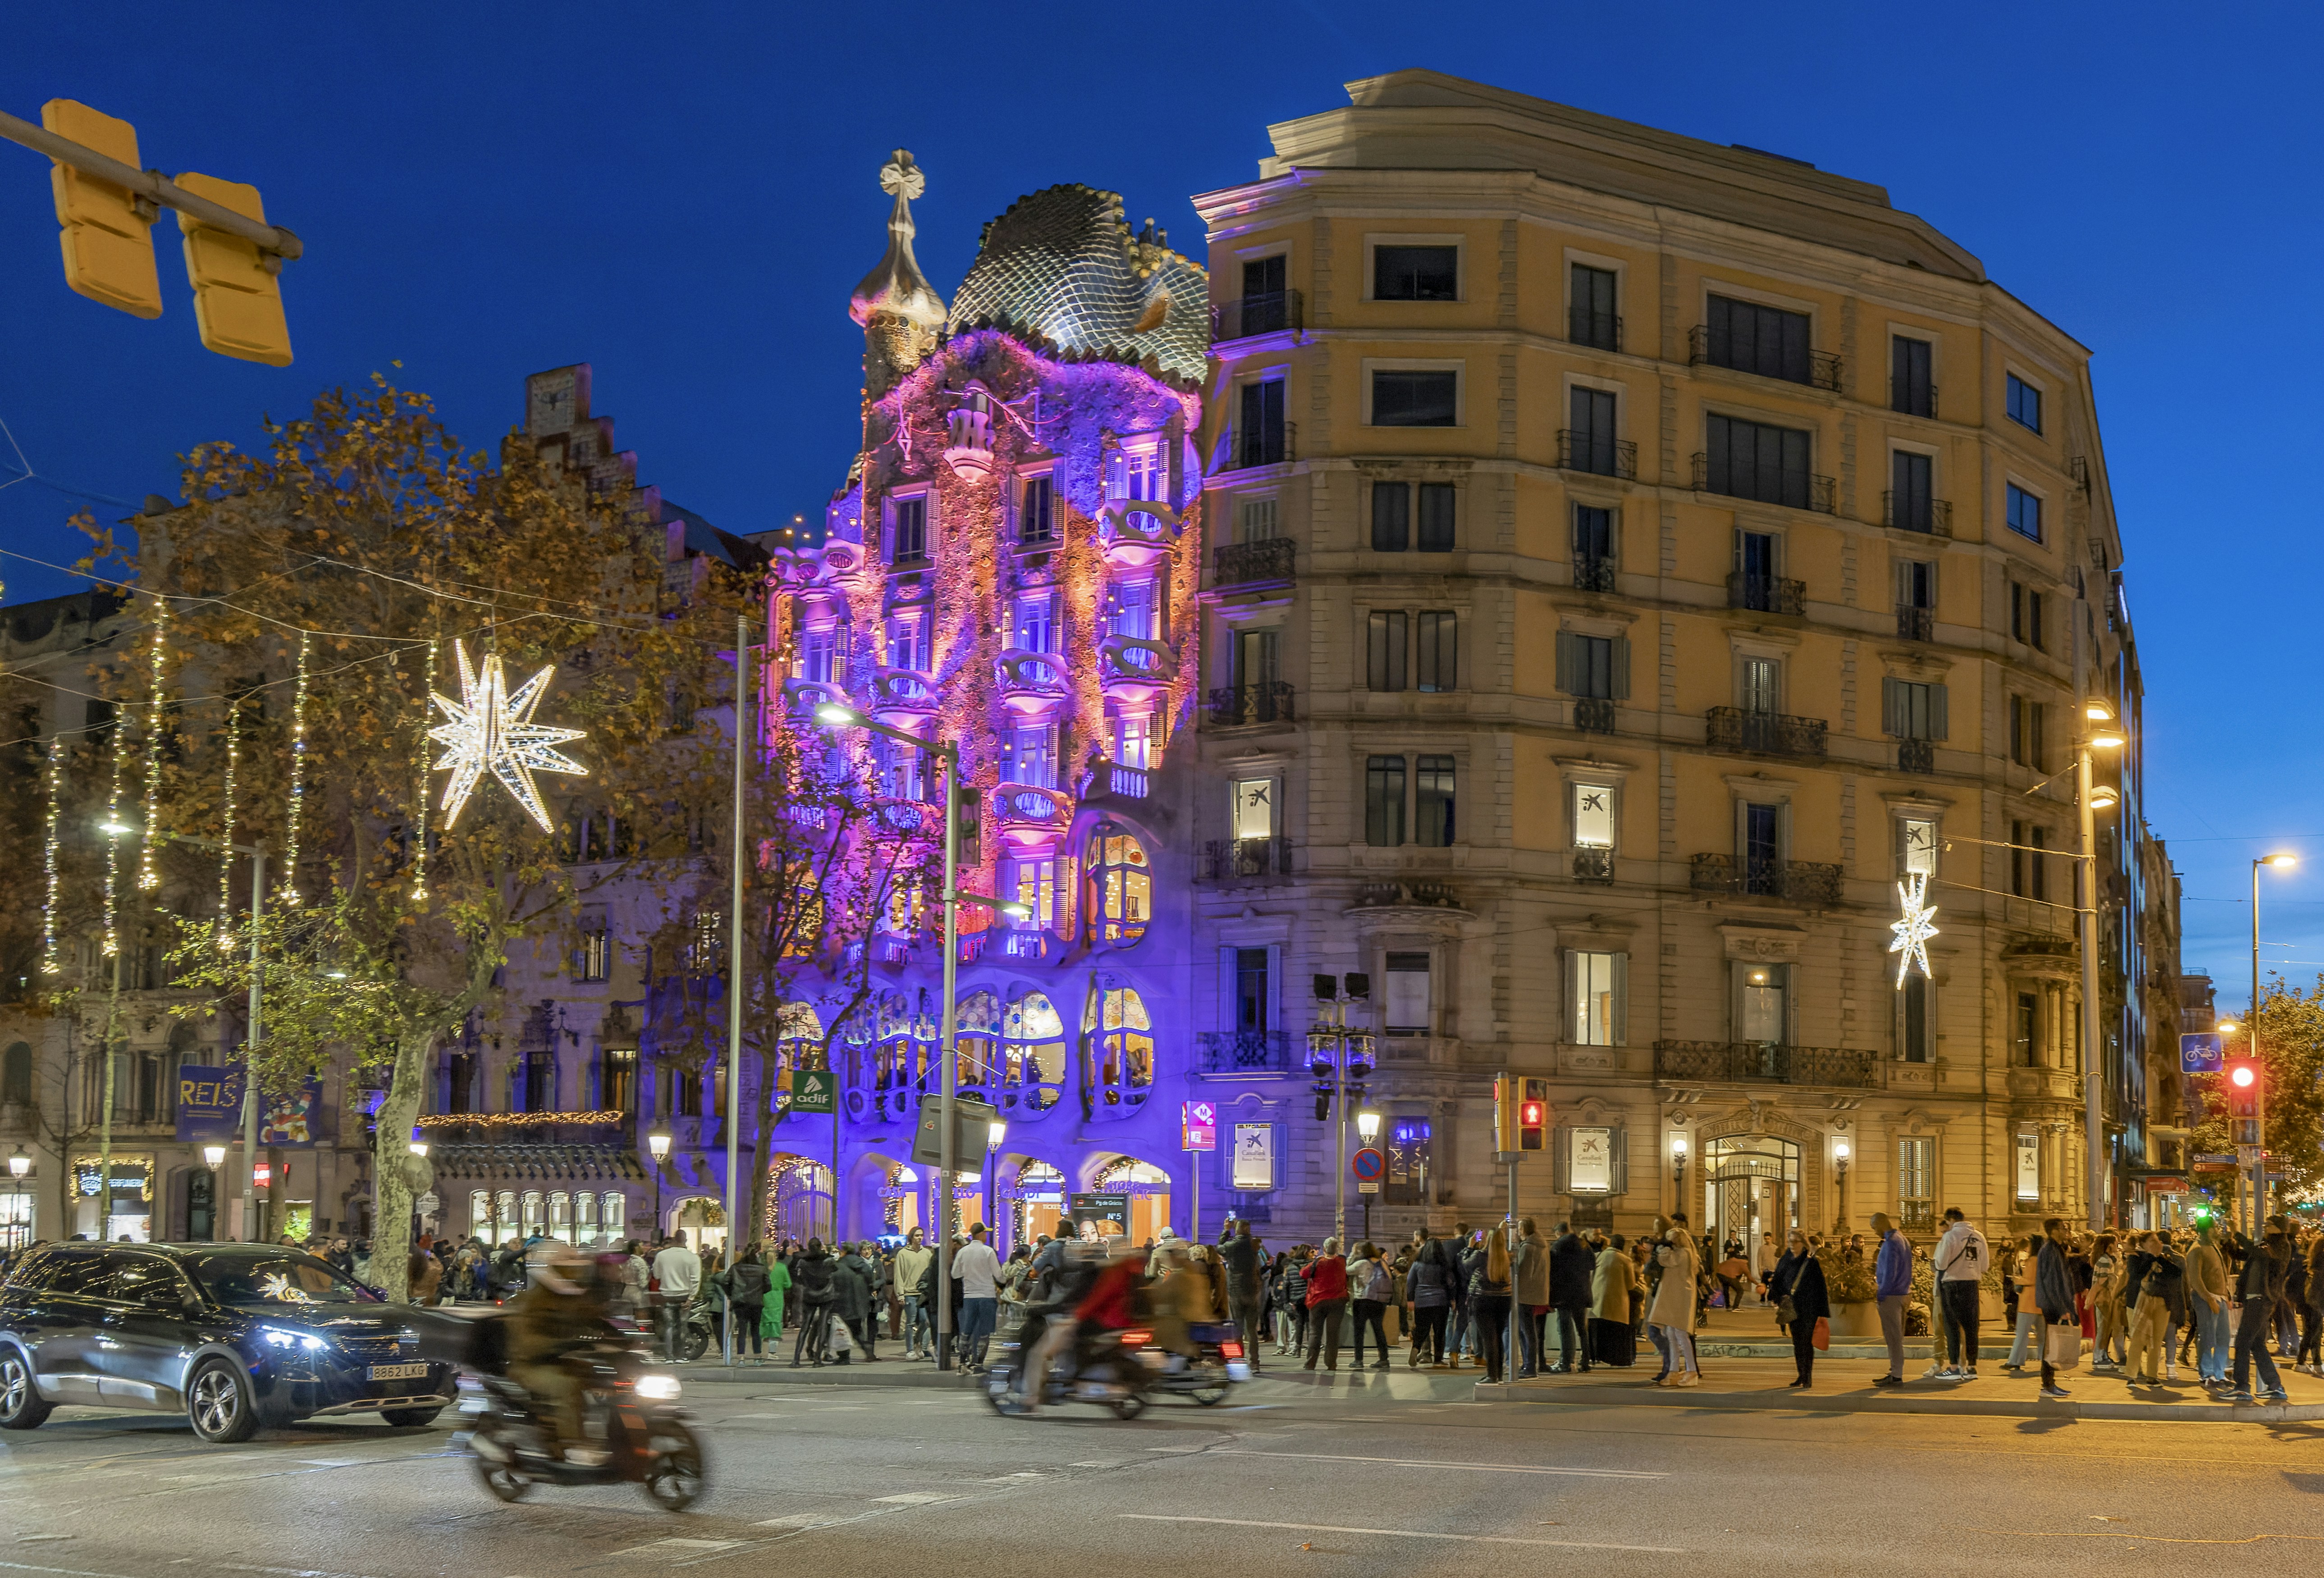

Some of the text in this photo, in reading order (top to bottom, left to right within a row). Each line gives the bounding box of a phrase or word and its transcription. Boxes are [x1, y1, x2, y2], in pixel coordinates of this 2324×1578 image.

[180, 1080, 237, 1107] REIS
[796, 1093, 829, 1104] adif
[877, 1186, 906, 1198] CASA
[374, 1365, 424, 1378] 8862 LKG
